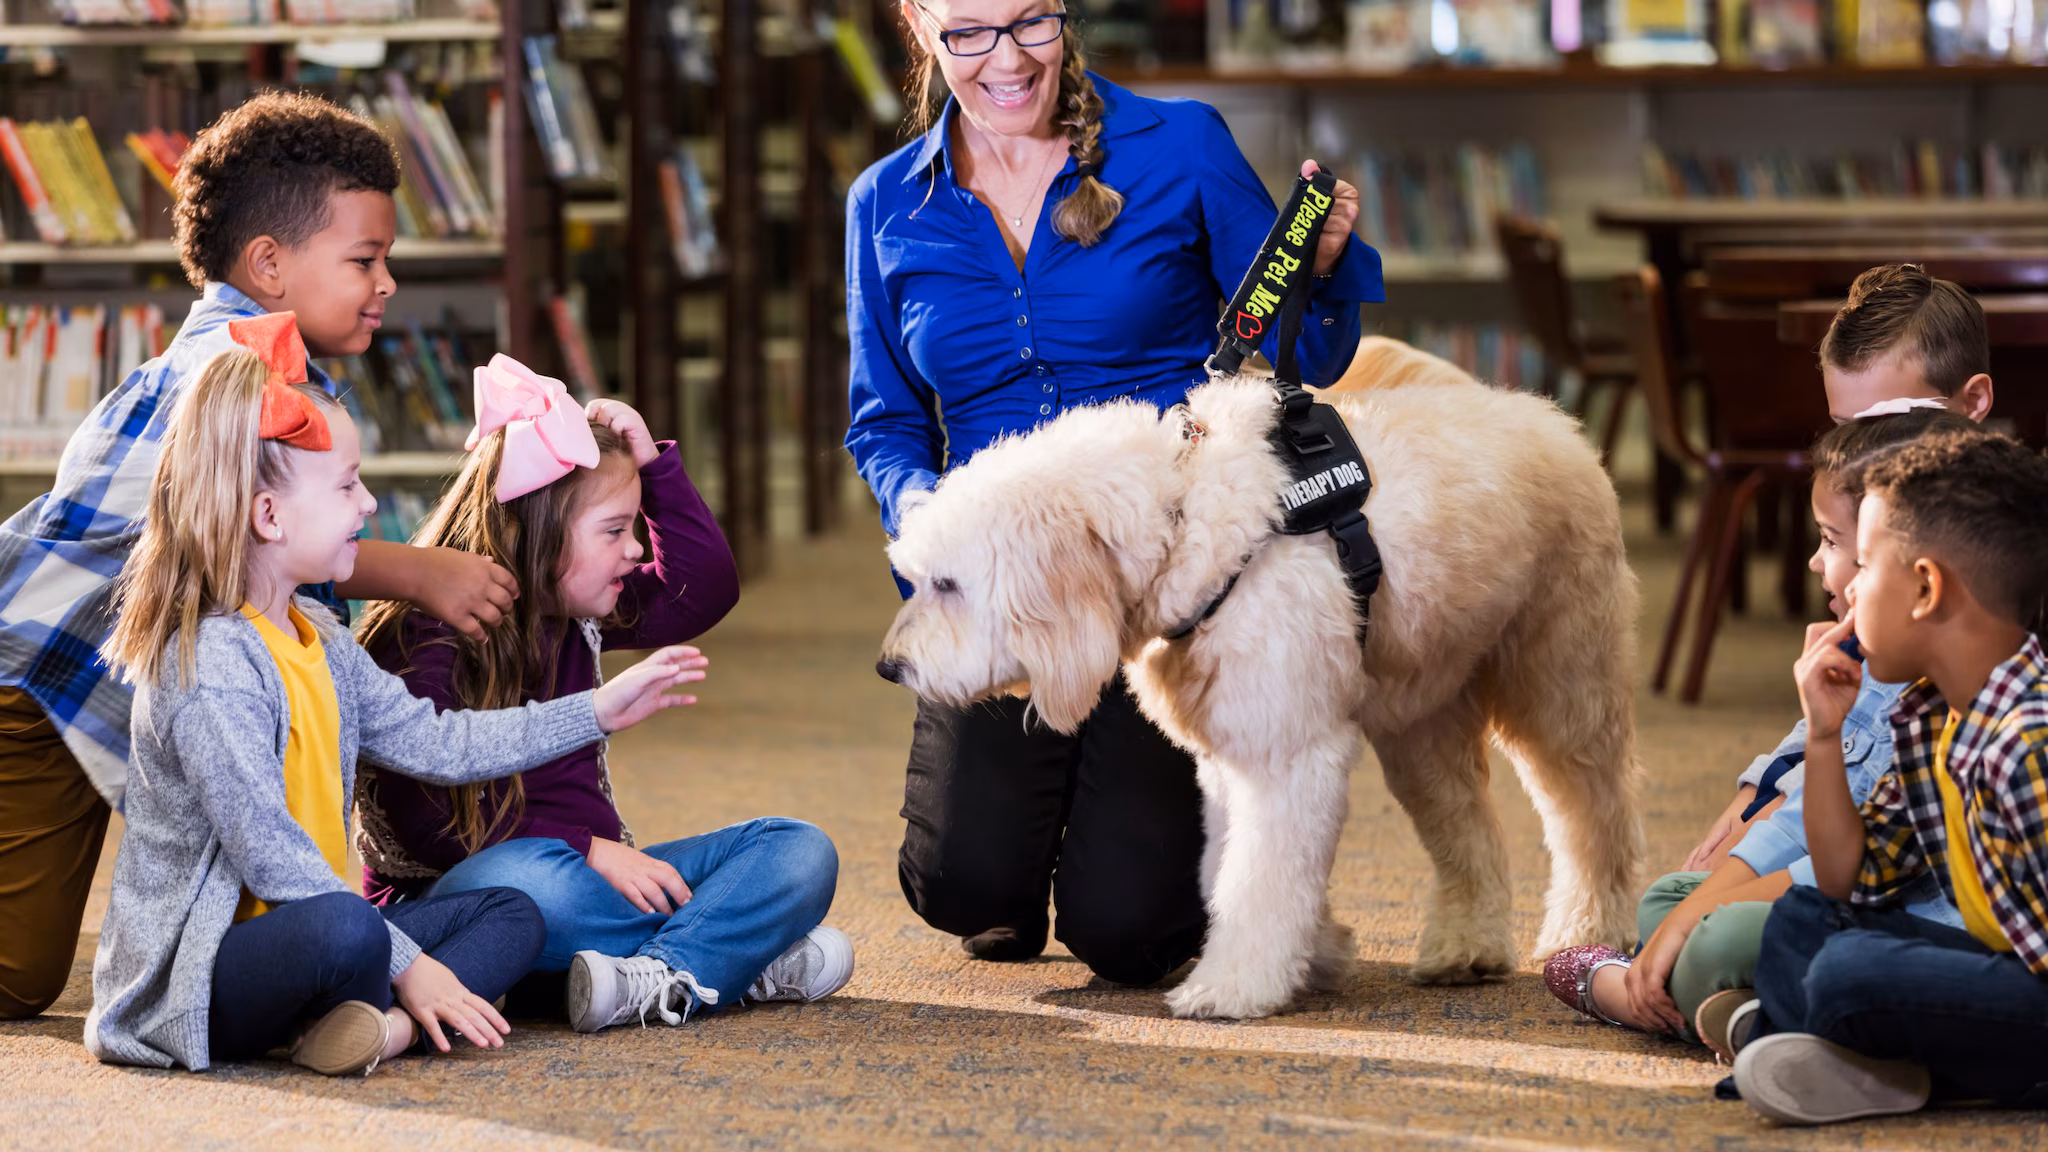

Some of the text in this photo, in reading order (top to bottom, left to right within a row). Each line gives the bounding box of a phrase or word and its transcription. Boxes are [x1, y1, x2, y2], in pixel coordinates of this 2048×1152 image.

[1245, 184, 1332, 318] Please Pet Me
[1281, 461, 1365, 511] THERAPY DOG
